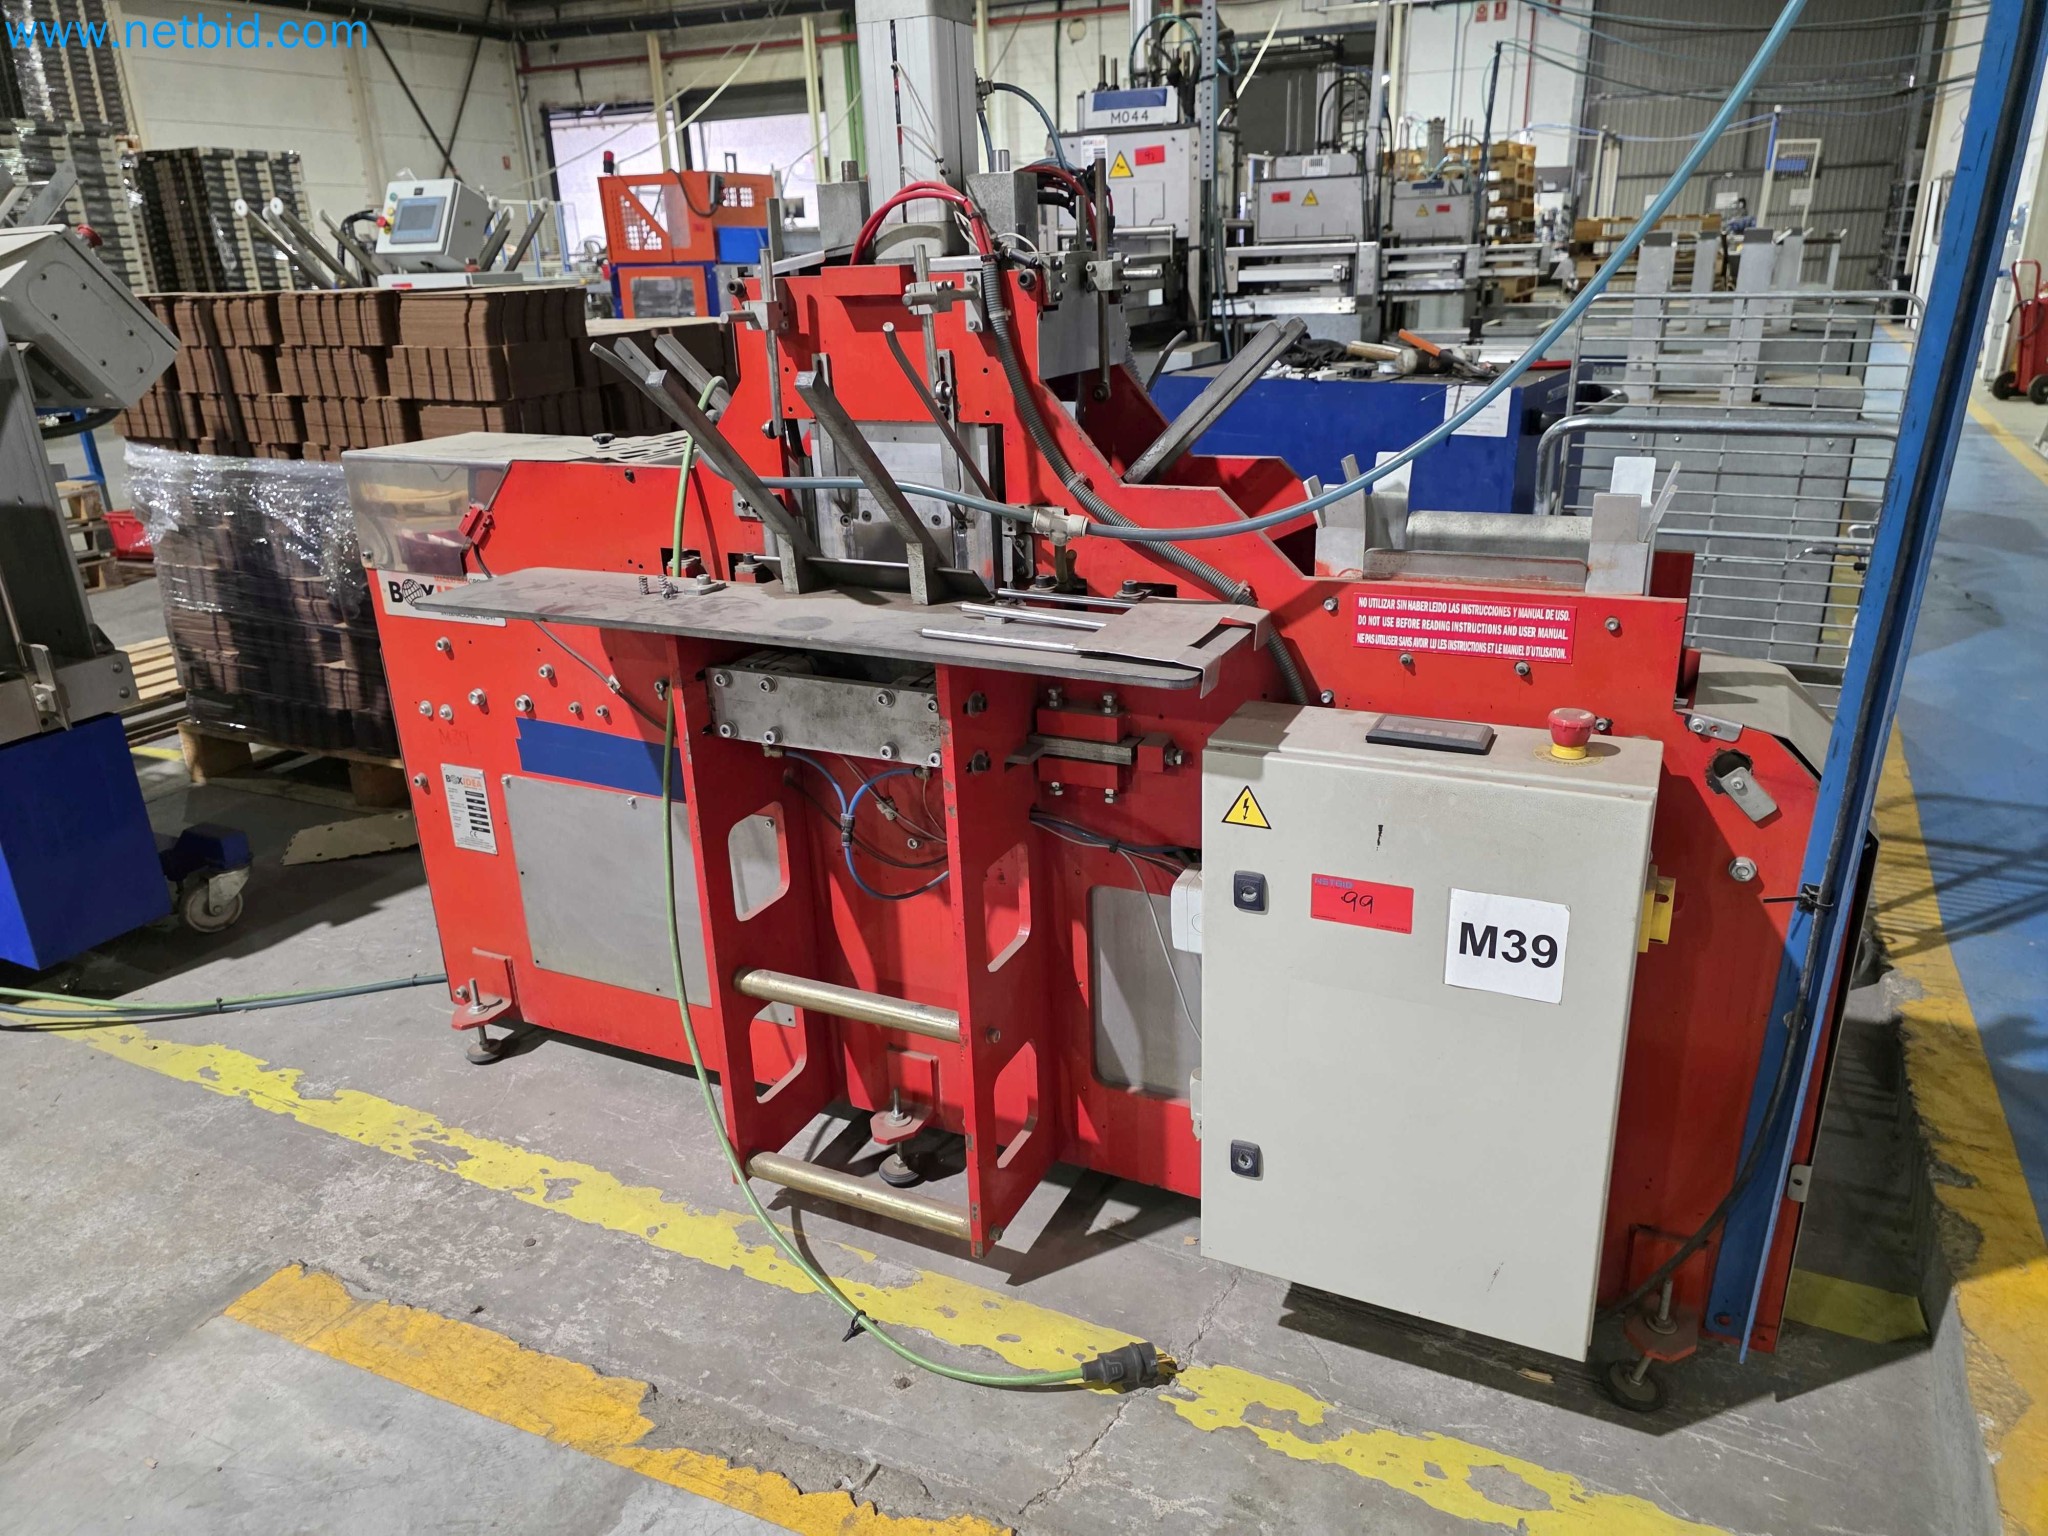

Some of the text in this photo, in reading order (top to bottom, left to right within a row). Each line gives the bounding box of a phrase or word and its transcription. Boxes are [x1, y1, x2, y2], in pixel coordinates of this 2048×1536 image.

[1358, 596, 1570, 621] NO UTILIZAR SIN HABER LEIDO LAS INSTRUCCIONES Y MANUAL DE USO.
[1358, 614, 1569, 640] DO NOT USE BEFORE READING INSTRUCTIONS AND USER MANUAL.
[1356, 632, 1365, 643] NE
[1365, 634, 1375, 645] PAS
[1375, 634, 1398, 647] UTILISER
[1398, 636, 1413, 647] SANS
[1412, 637, 1428, 648] AVOIR
[1429, 638, 1437, 649] LU
[1437, 638, 1447, 650] LES
[1448, 639, 1487, 654] INSTRUCTIONS
[1487, 642, 1494, 654] ET
[1495, 643, 1503, 655] LE
[1503, 643, 1525, 656] MANUEL
[1341, 891, 1374, 914] 99
[1459, 922, 1558, 968] M39
